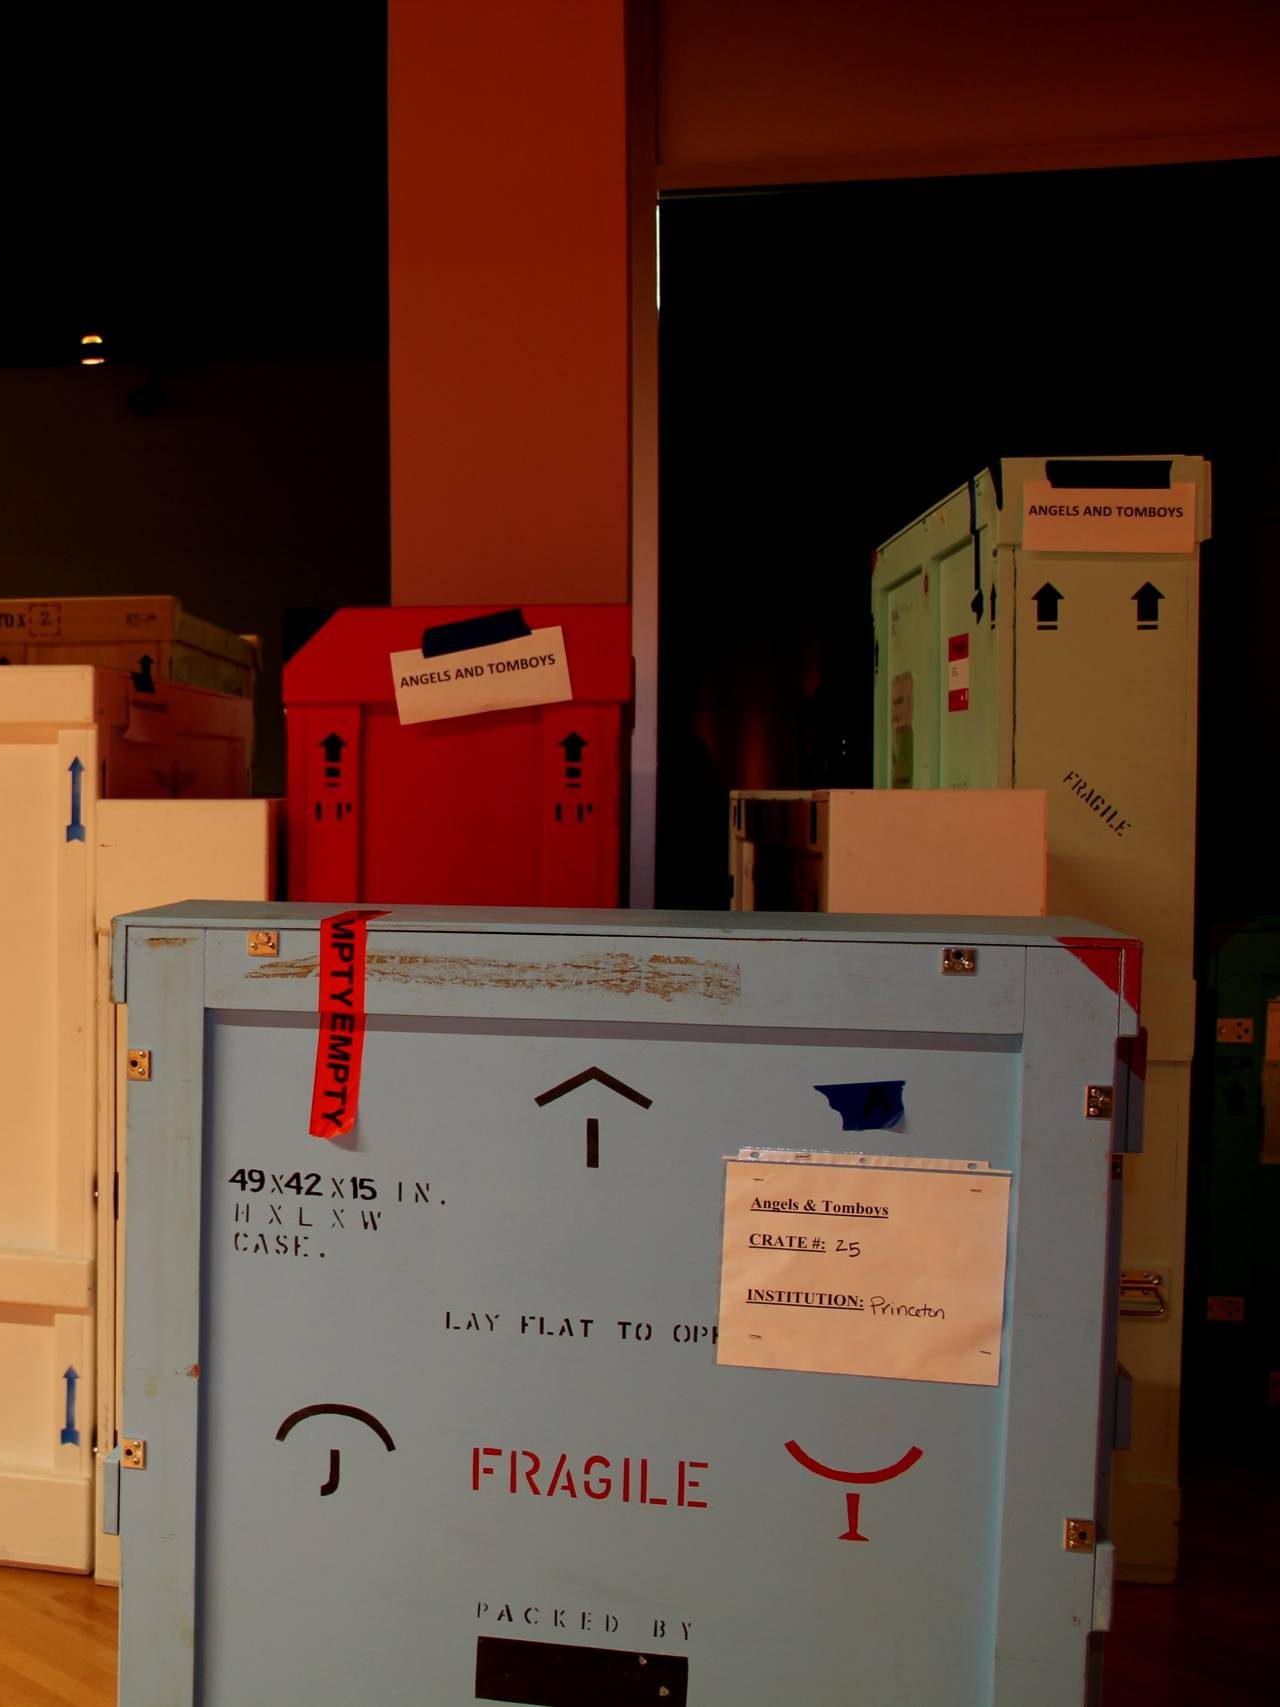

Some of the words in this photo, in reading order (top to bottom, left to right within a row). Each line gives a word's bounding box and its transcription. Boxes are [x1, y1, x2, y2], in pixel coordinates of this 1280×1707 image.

[1028, 505, 1080, 516] ANGELS
[1082, 505, 1113, 517] AND
[1116, 506, 1184, 518] TOMBOYS
[400, 669, 452, 689] ANGELS
[454, 664, 485, 681] AND
[487, 654, 556, 676] TOMBOYS
[1062, 770, 1132, 837] FRAGILE
[321, 1012, 356, 1128] EMPTY
[751, 1197, 800, 1213] Angels
[803, 1199, 817, 1212] &
[821, 1200, 889, 1217] Tomboys
[749, 1233, 808, 1249] CRATE
[835, 1239, 862, 1258] 25
[746, 1289, 864, 1309] INSTITUTION:
[869, 1295, 946, 1320] Princeton
[445, 1311, 500, 1332] LAY
[521, 1315, 595, 1338] FLAT
[617, 1321, 652, 1341] TO
[472, 1446, 710, 1509] FRAGILE
[477, 1601, 620, 1633] PACKED
[652, 1619, 693, 1641] BY
